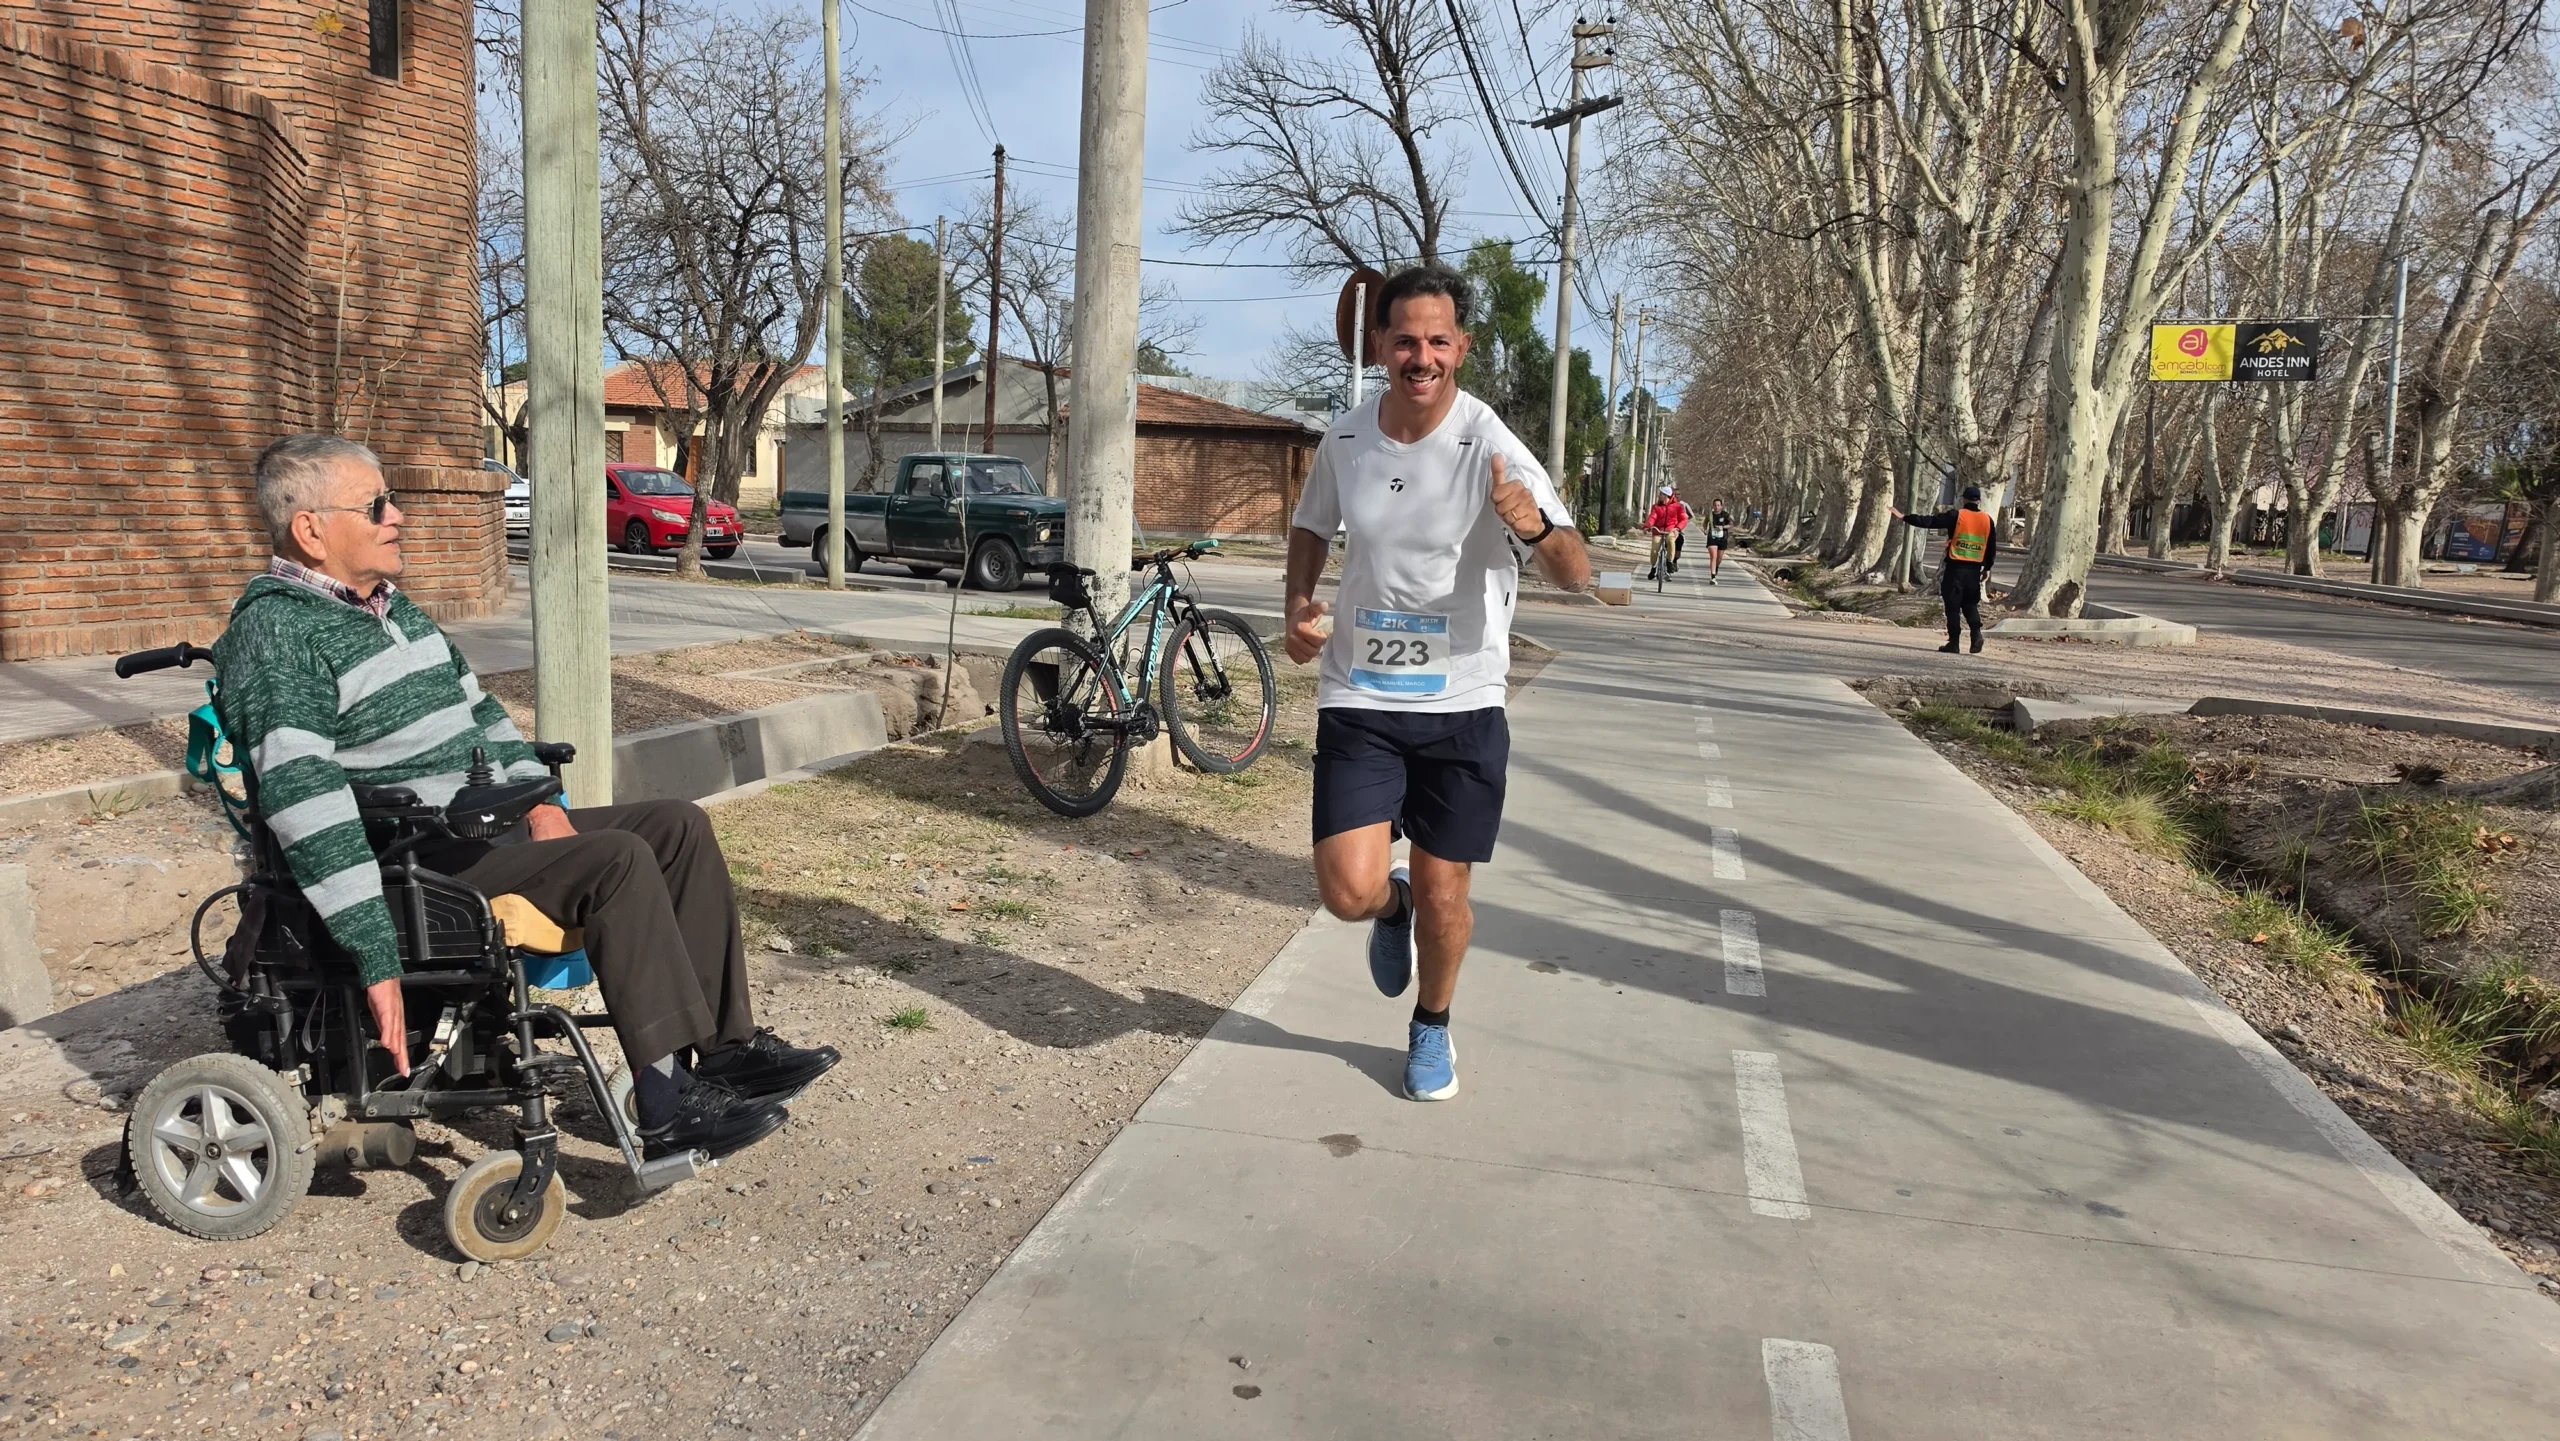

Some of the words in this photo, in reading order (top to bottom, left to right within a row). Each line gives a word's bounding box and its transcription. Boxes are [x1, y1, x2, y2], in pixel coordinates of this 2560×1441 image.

[2239, 357, 2284, 368] ANDES
[2286, 356, 2310, 368] INN
[2257, 369, 2289, 377] HOTEL
[1381, 617, 1409, 630] 21K
[1146, 609, 1165, 683] TOPMEGA
[1366, 638, 1430, 666] 223
